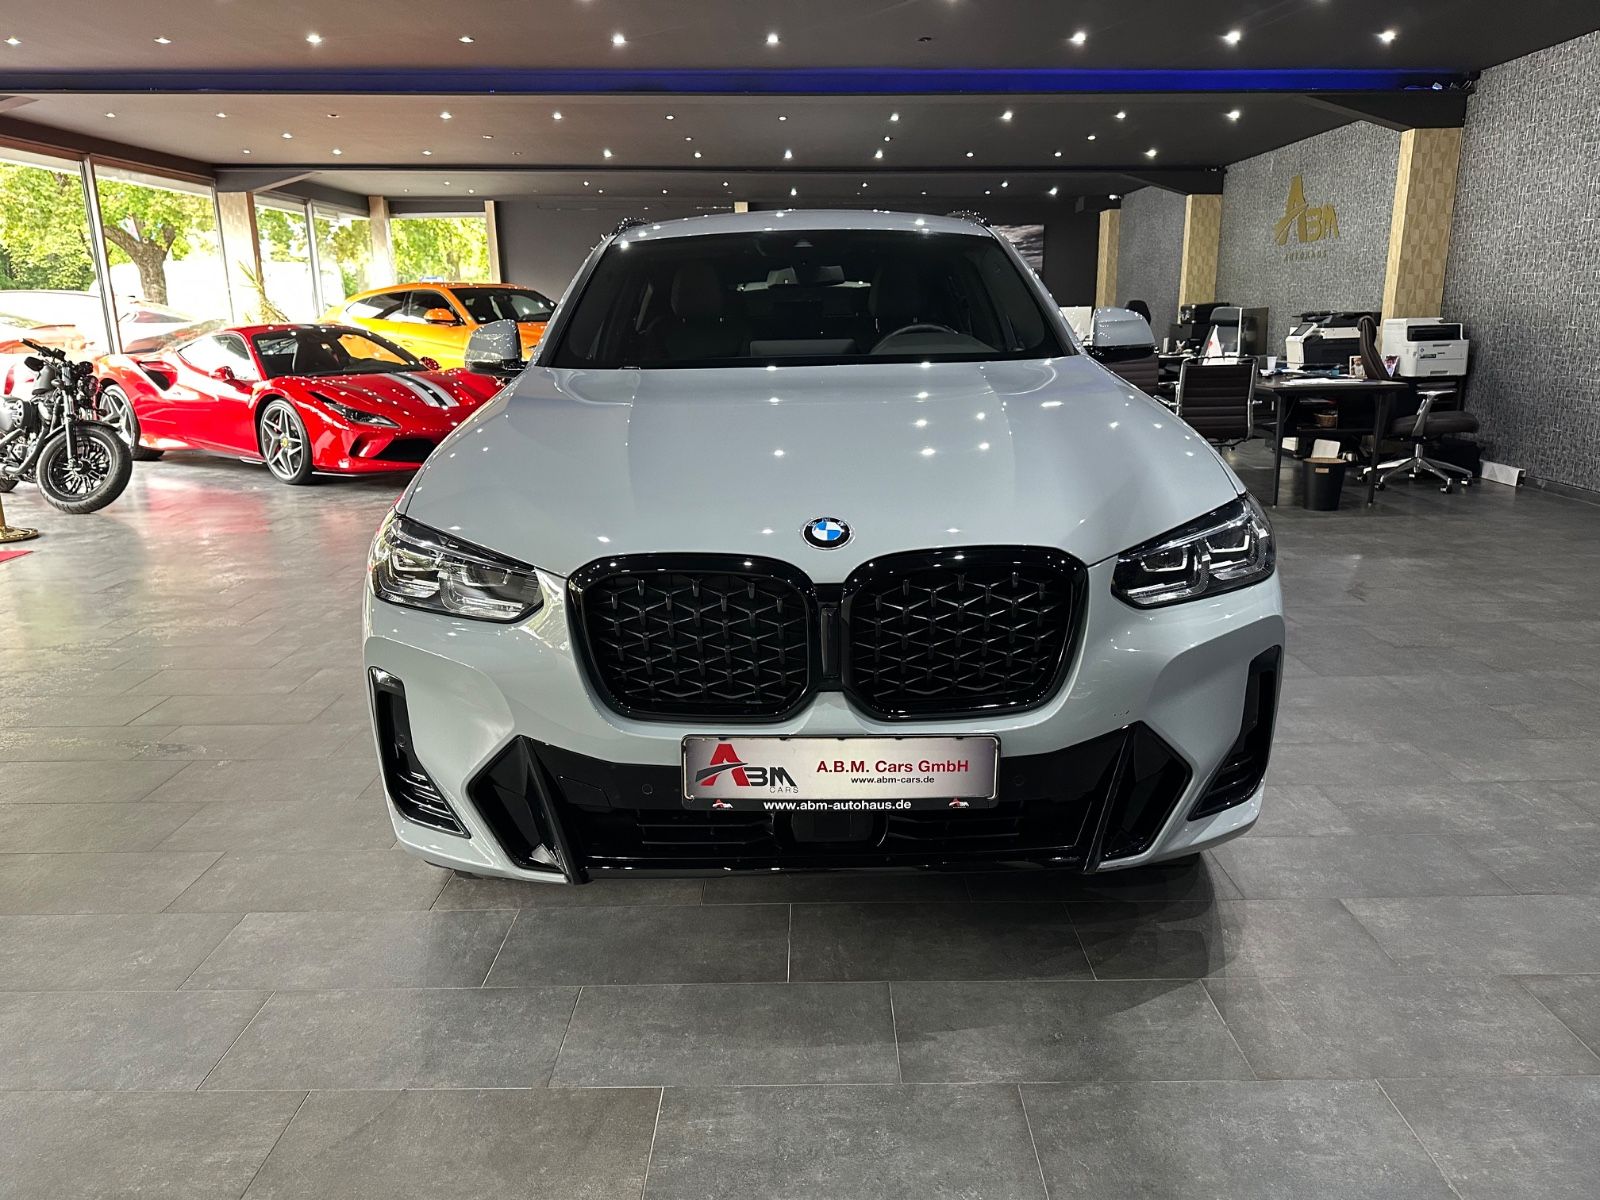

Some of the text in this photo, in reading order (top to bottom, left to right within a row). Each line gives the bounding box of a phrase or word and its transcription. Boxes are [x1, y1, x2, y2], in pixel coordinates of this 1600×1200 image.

[1273, 174, 1340, 246] ABM
[695, 743, 798, 787] ABM
[816, 759, 969, 773] A.B.M. Cars GmbH
[850, 776, 935, 784] www.abm-cars.de
[769, 786, 799, 794] CARS
[763, 799, 912, 811] www.abm-autohaus.de
